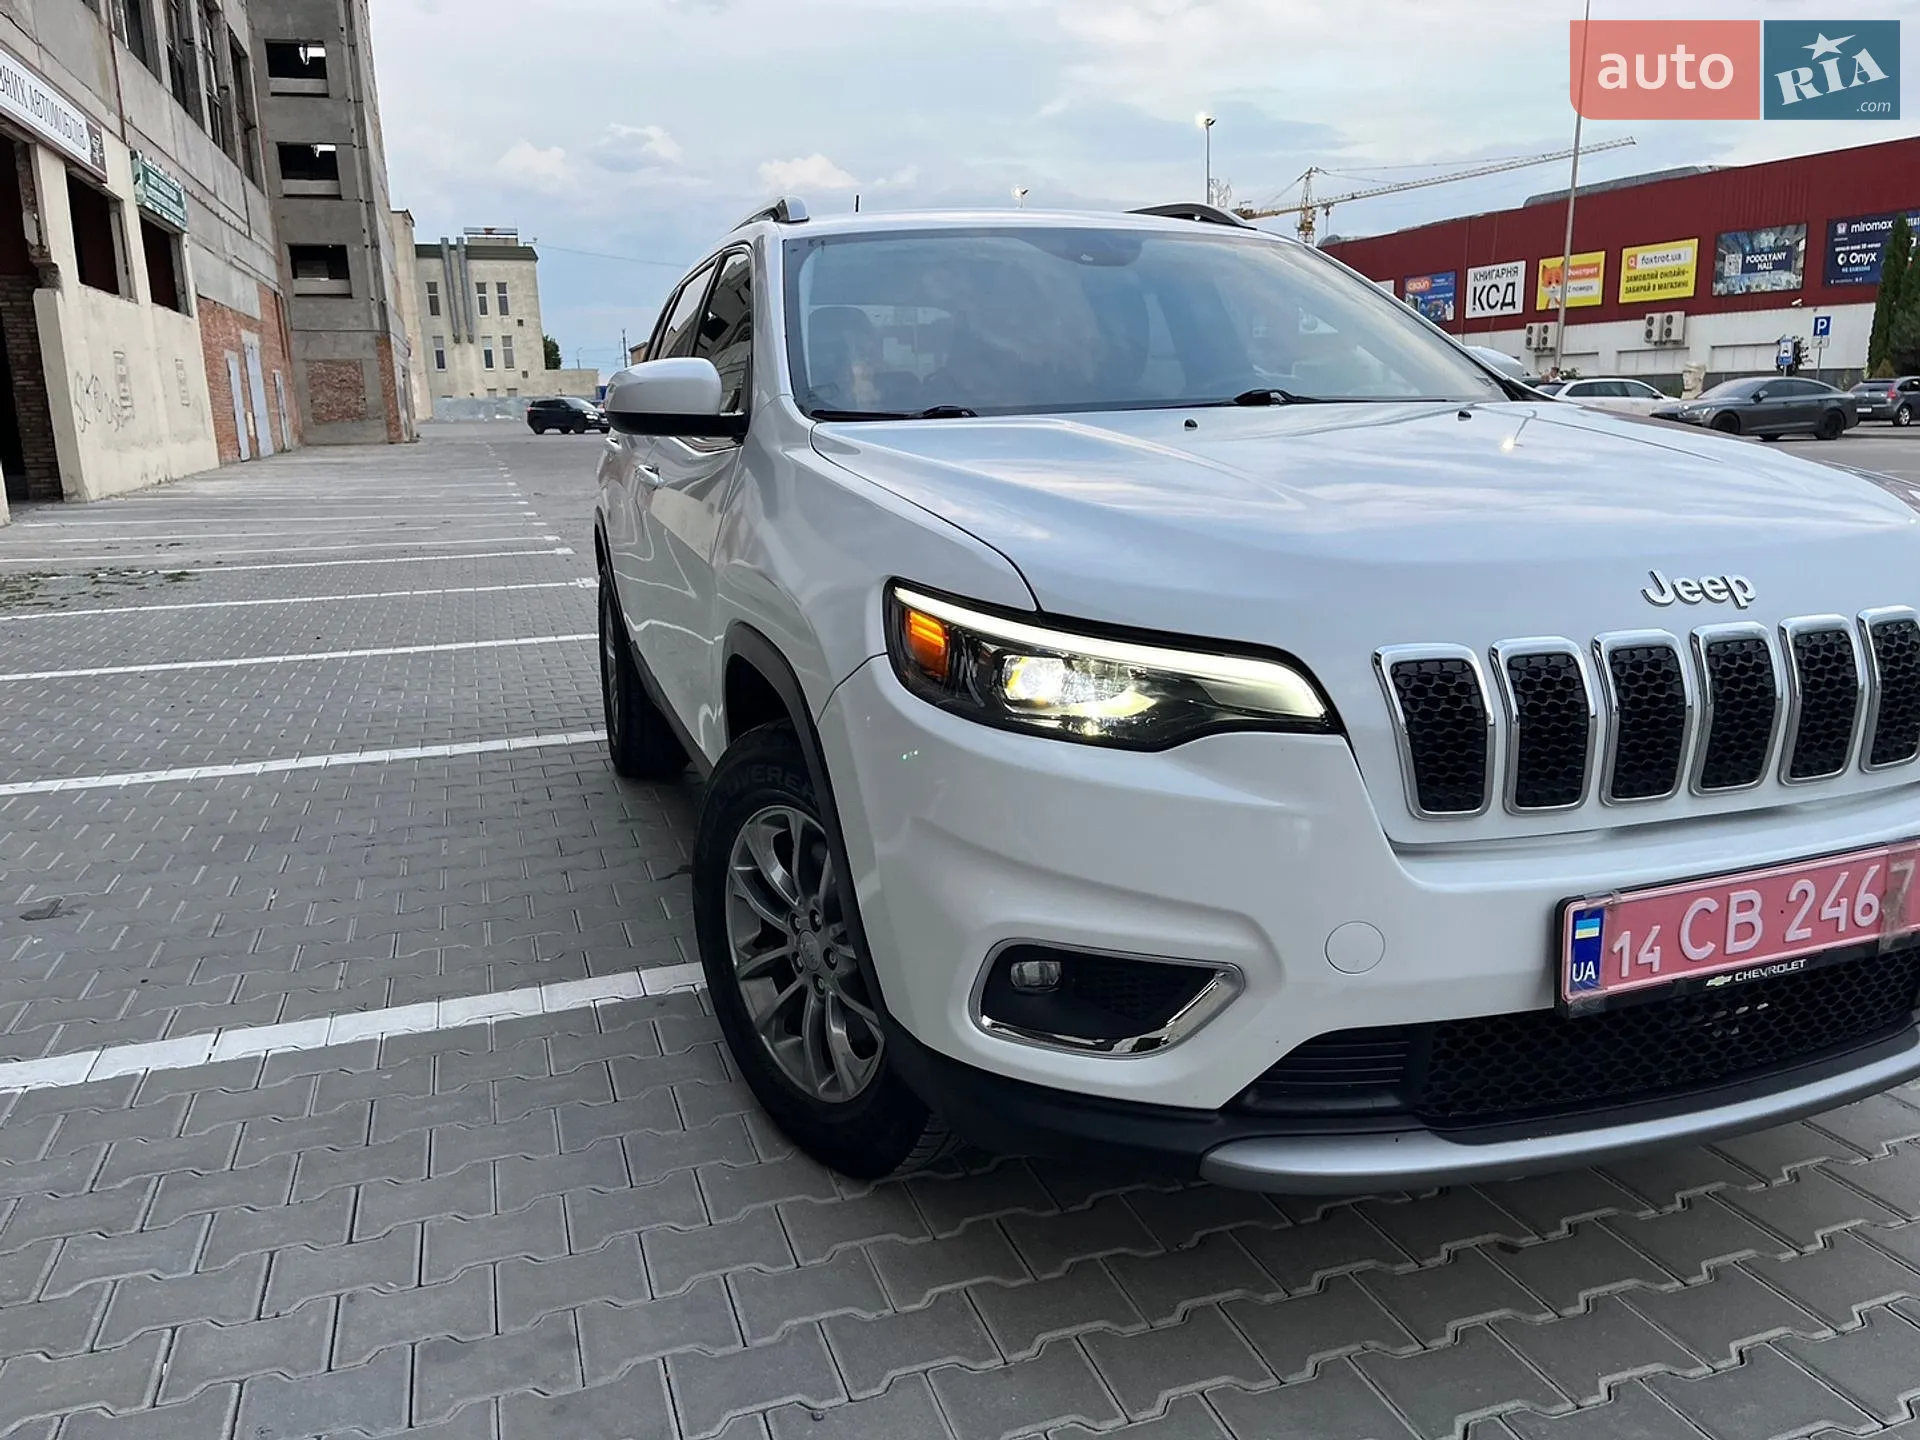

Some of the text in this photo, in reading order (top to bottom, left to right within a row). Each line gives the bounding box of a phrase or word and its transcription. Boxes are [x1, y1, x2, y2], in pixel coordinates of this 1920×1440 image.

[1850, 219, 1894, 233] miromax
[1641, 253, 1682, 265] foxtrot.ua
[1745, 251, 1787, 264] PODOLYANY
[1849, 252, 1877, 265] Onyx
[1473, 266, 1519, 281] КНИГАРНЯ
[1817, 318, 1827, 335] P
[1640, 568, 1757, 610] Jeep
[1612, 924, 1662, 978] 14
[1679, 889, 1763, 962] CB
[1572, 959, 1596, 983] UA
[1734, 958, 1808, 983] CHEVROLET
